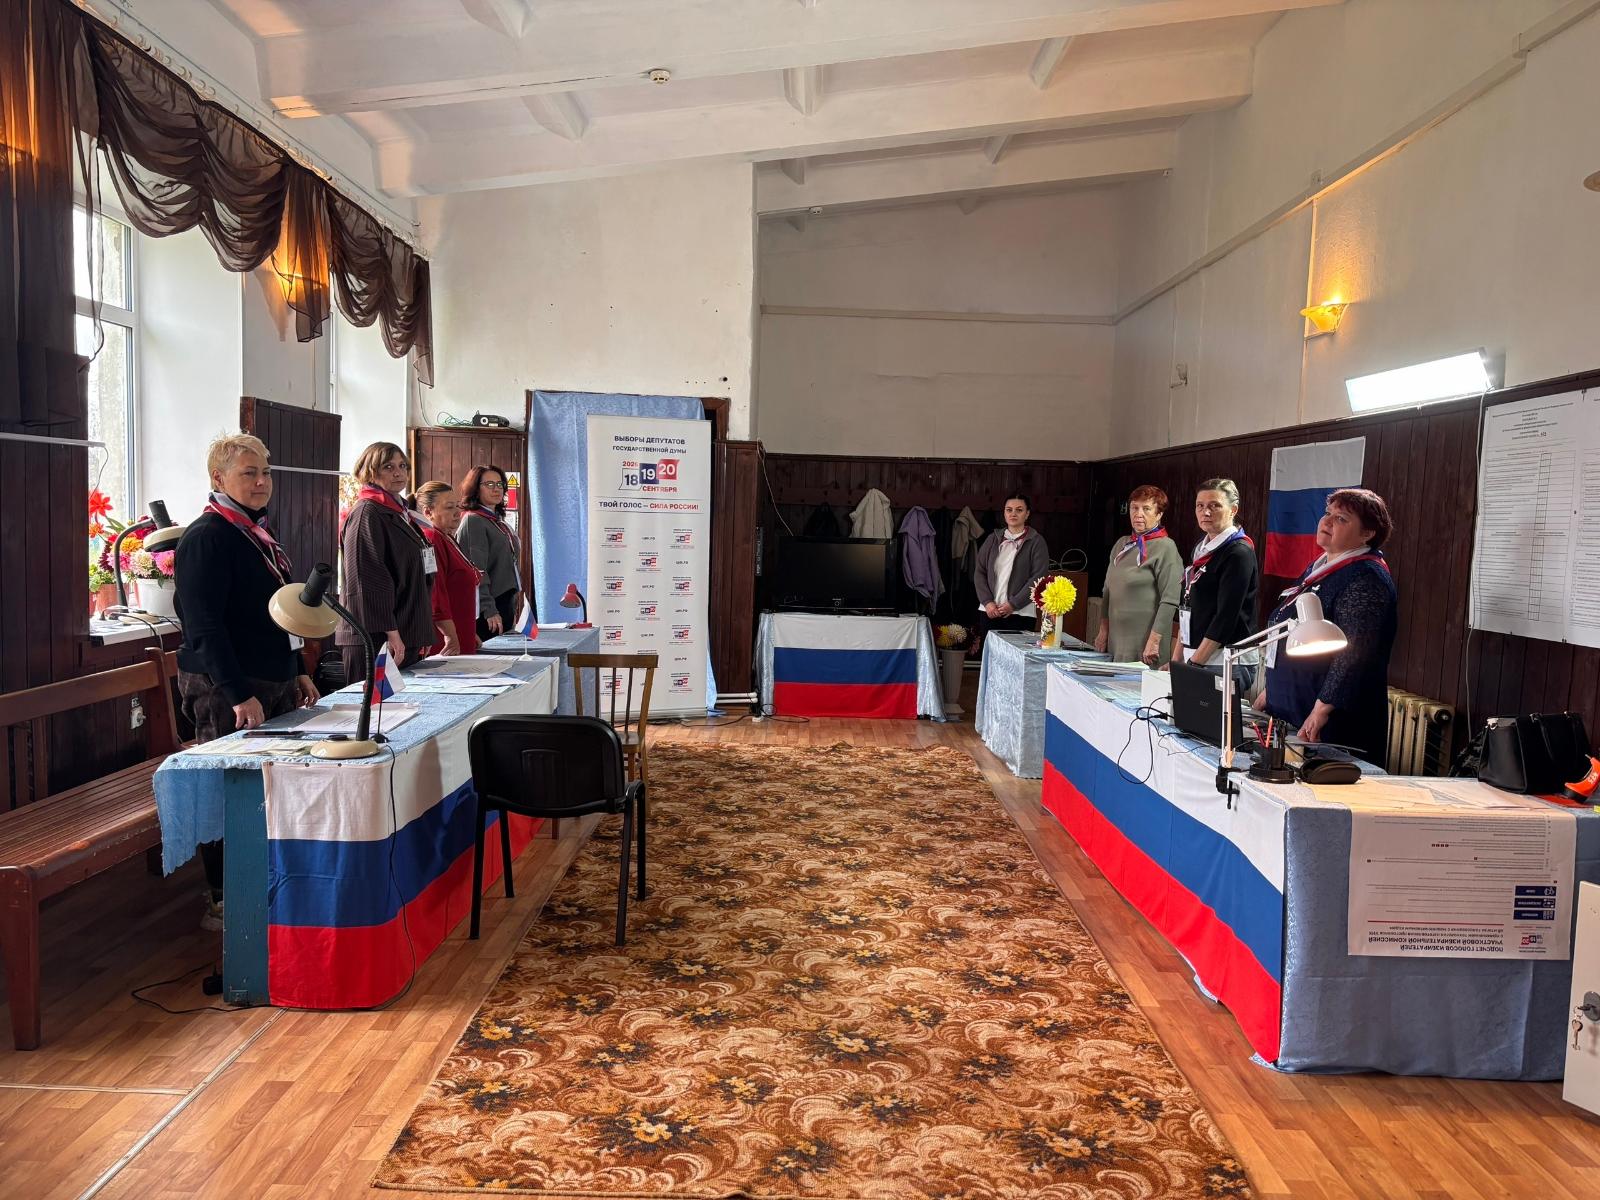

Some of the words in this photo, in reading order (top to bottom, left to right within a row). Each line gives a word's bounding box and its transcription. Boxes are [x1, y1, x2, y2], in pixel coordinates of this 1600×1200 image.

[614, 435, 645, 443] ВЫБОРЫ
[646, 437, 686, 445] ДЕПУТАТОВ
[612, 445, 669, 454] ГОСУДАРСТВЕННОЙ
[624, 474, 639, 486] 18
[641, 468, 656, 481] 19
[658, 463, 676, 476] 20
[642, 485, 678, 493] СЕНТЯБРЯ
[599, 500, 618, 508] ТВОЙ
